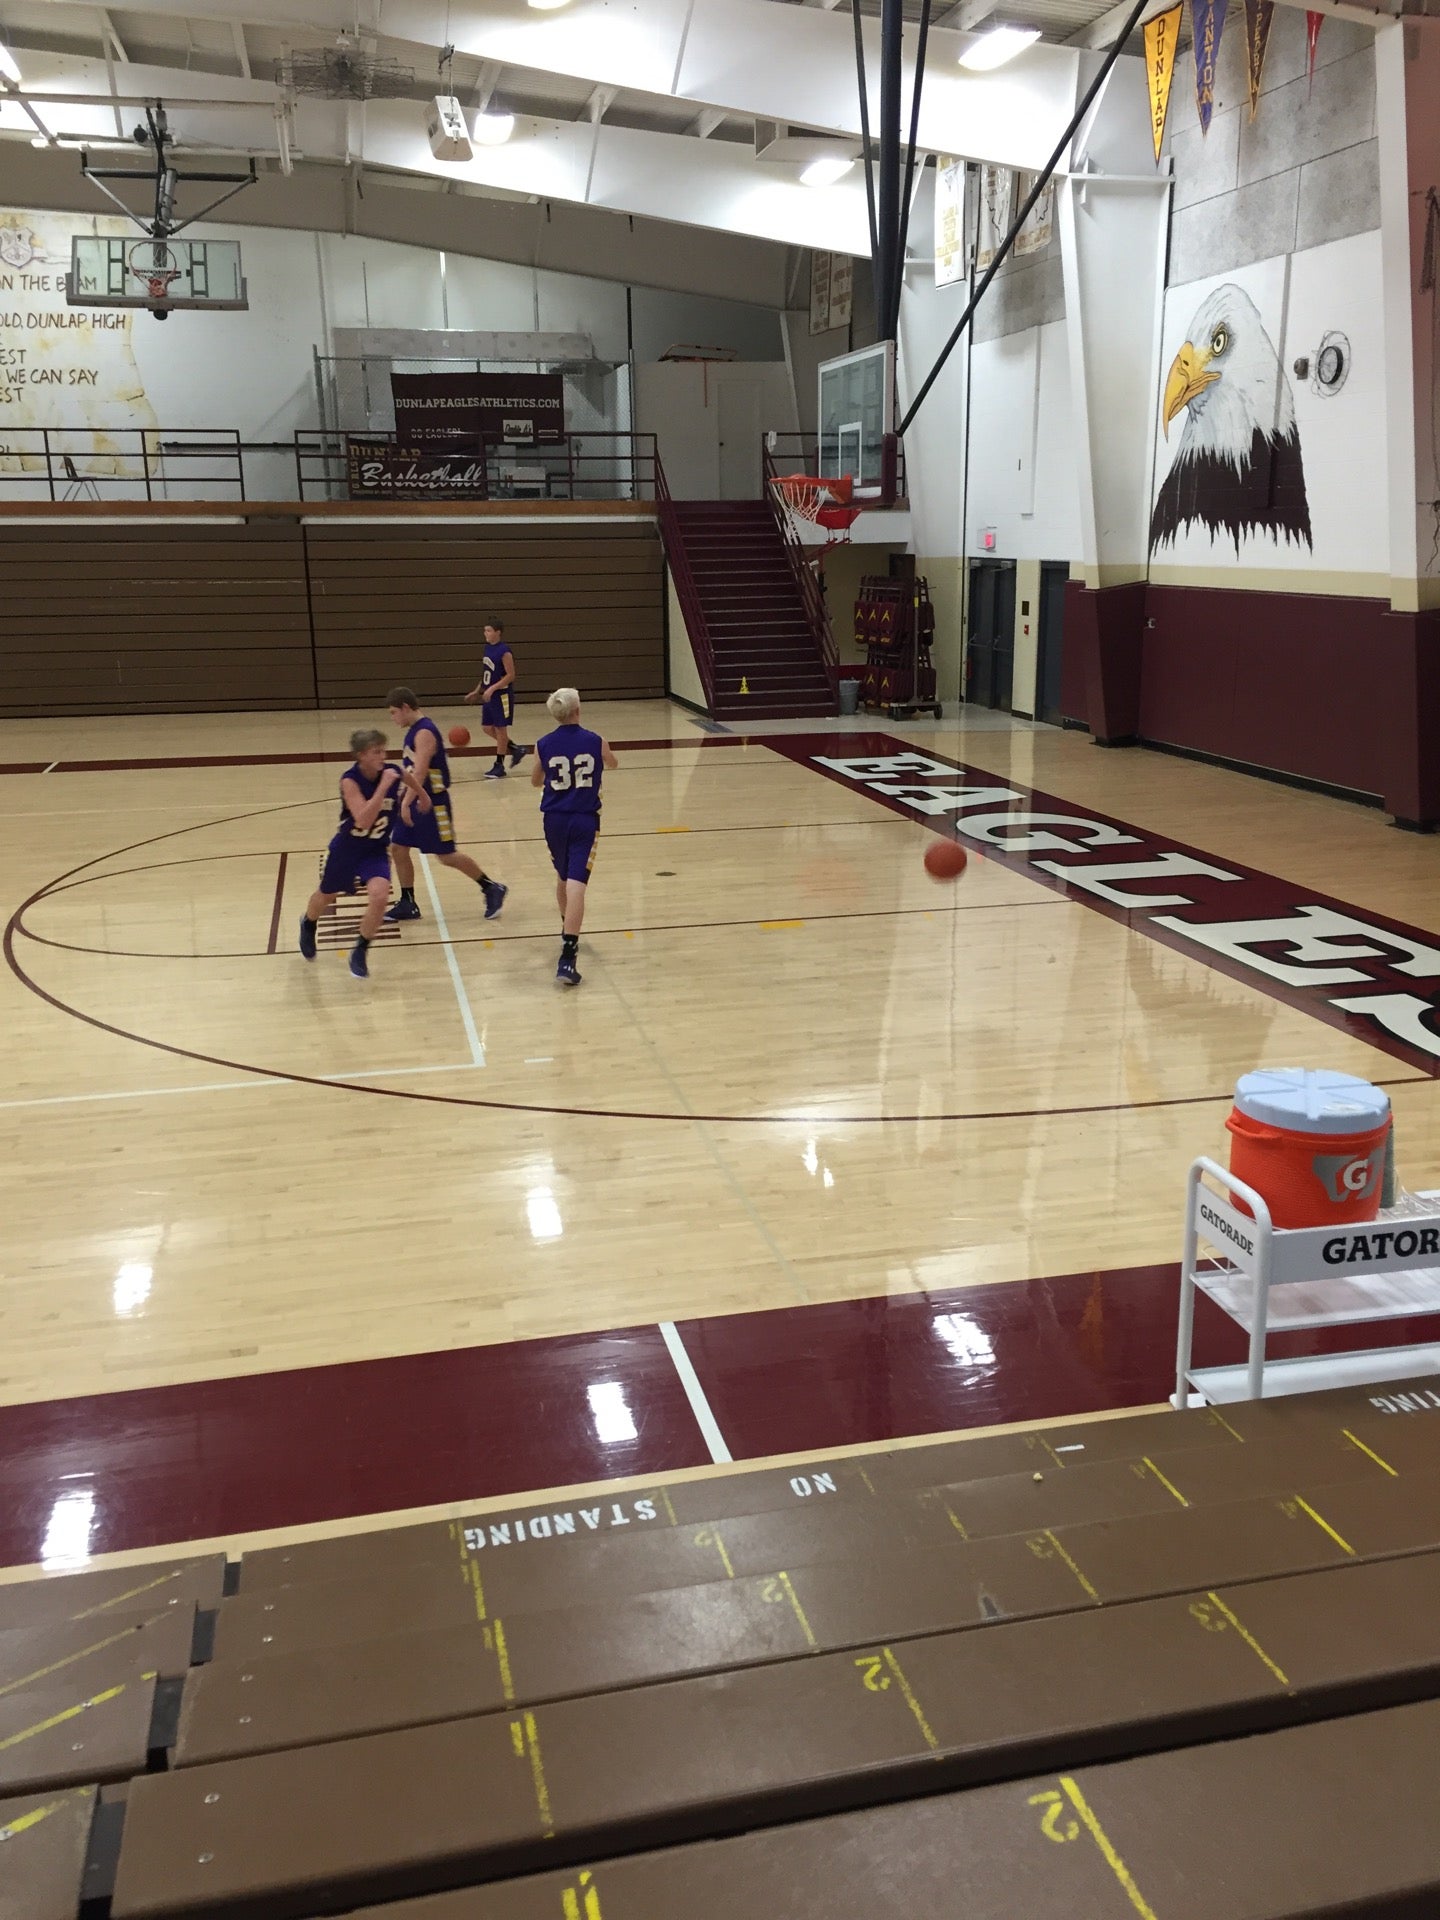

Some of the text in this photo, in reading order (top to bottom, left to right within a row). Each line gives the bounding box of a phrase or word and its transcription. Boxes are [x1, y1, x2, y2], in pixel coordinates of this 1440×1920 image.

[1201, 0, 1214, 104] ANTON
[1154, 17, 1166, 135] DUNLAP
[0, 274, 97, 292] N THE BAM
[26, 312, 87, 329] DUNLAP
[92, 313, 126, 329] HIGH
[6, 369, 98, 385] WE CAN SAY
[395, 397, 560, 410] DUNLAPEAGLESATHLETICS.COM
[349, 444, 421, 461] DUNAP
[361, 462, 482, 489] Basketball
[549, 753, 595, 791] 32
[1343, 1158, 1368, 1191] G
[1199, 1203, 1255, 1257] GATORADE
[463, 1472, 838, 1551] NO STANDING
[854, 1655, 891, 1691] 2
[1028, 1790, 1080, 1843] 2
